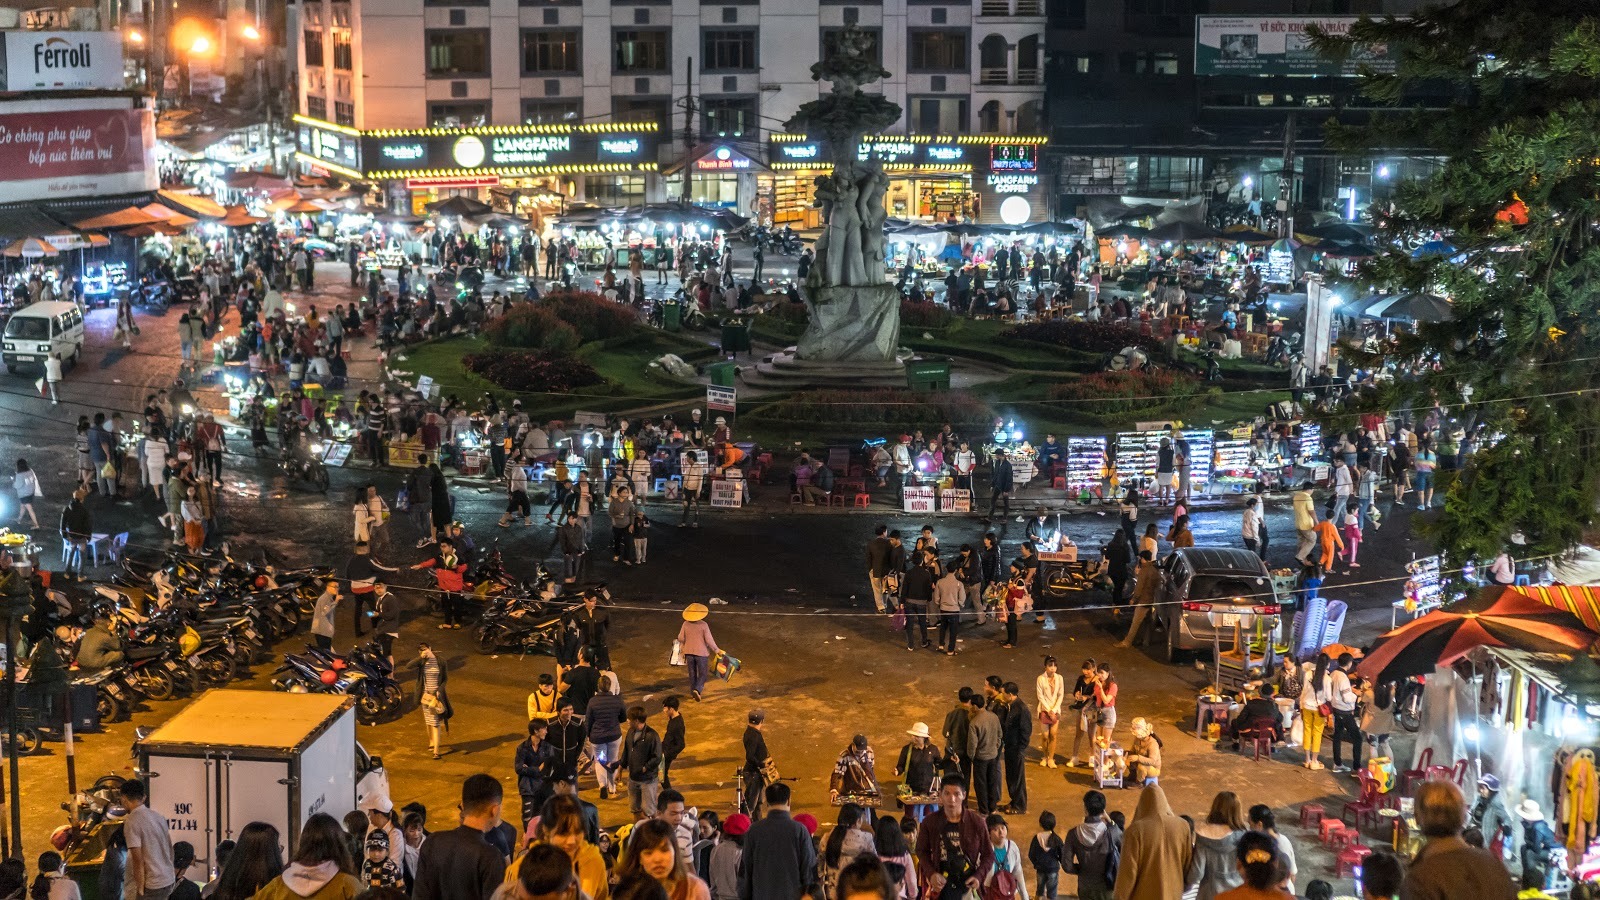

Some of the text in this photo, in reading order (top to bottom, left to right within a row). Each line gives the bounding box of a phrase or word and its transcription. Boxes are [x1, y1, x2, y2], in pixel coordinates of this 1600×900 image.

[1260, 21, 1268, 32] VÌ
[34, 43, 90, 74] Ferroli
[15, 126, 44, 148] chồng
[47, 126, 66, 145] phụ
[70, 125, 91, 145] giúp
[493, 137, 569, 151] L'ANGFARM
[29, 144, 113, 167] bếp núc thêm vui
[698, 160, 717, 168] Thanh
[987, 175, 1038, 185] L'ANGFARM
[995, 184, 1028, 193] COFFEE
[174, 803, 192, 814] 49C
